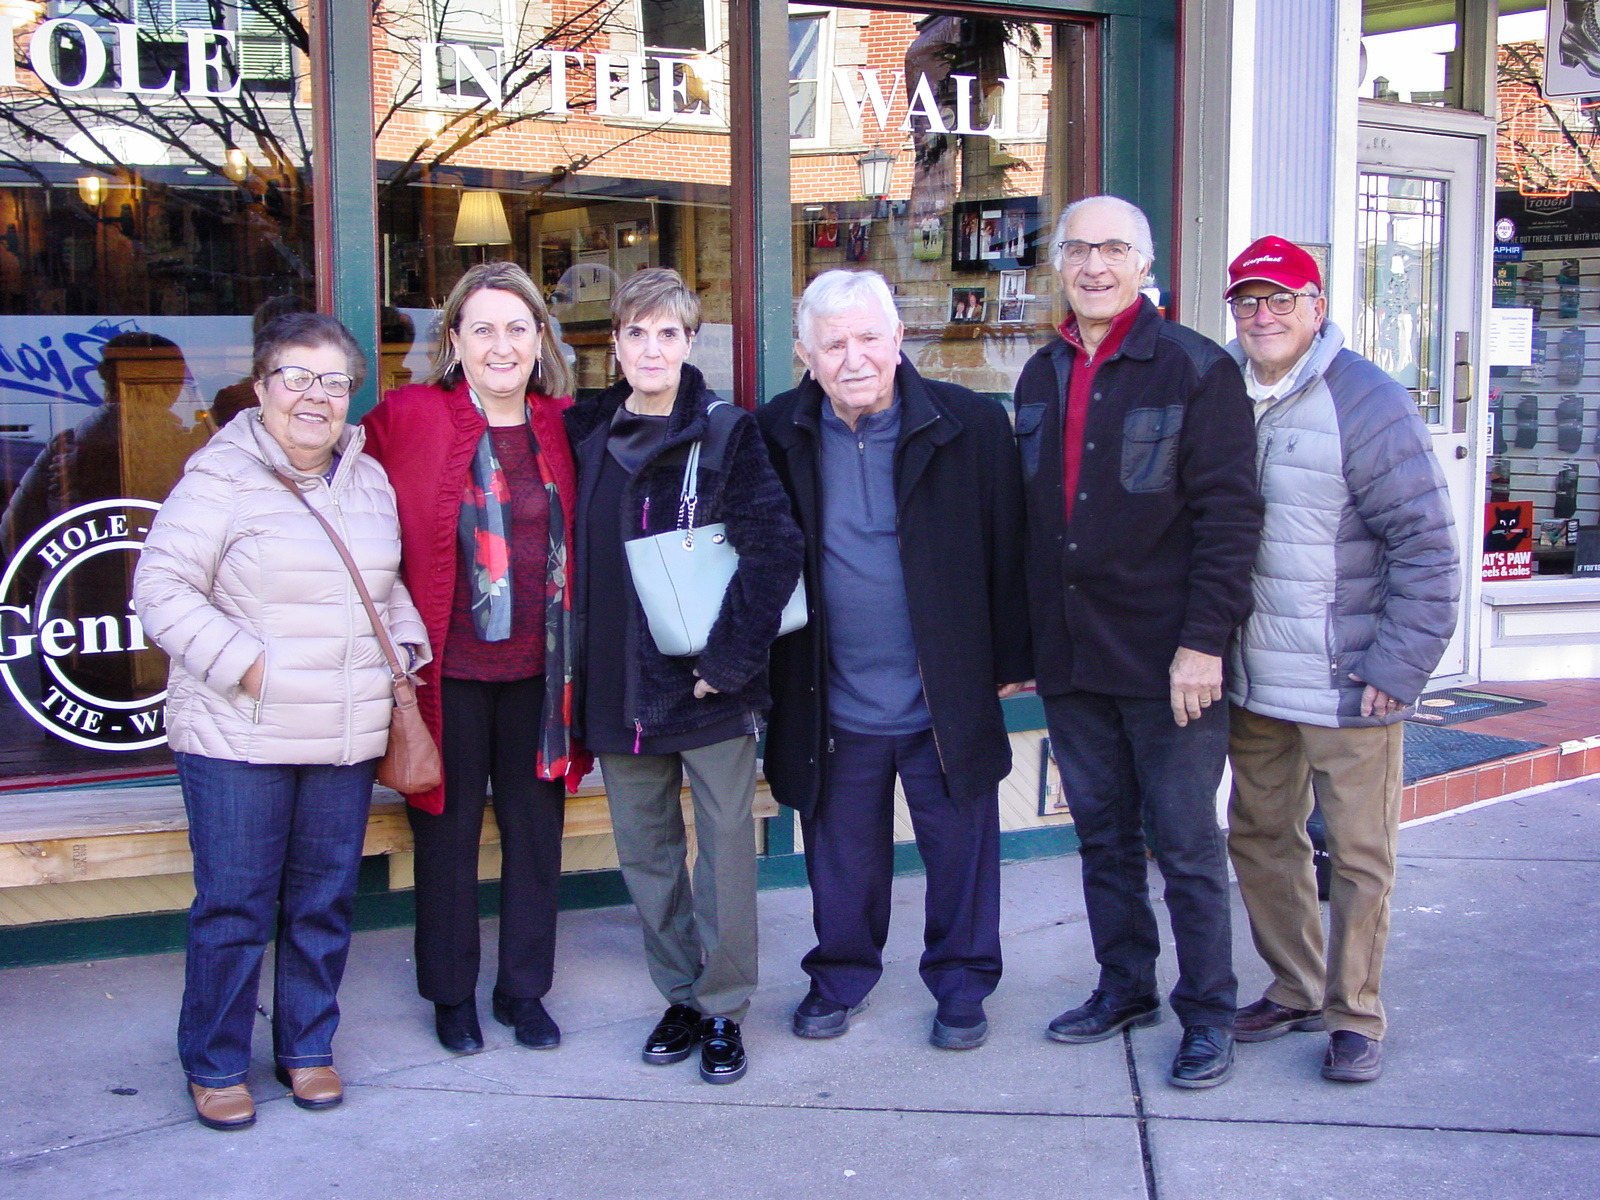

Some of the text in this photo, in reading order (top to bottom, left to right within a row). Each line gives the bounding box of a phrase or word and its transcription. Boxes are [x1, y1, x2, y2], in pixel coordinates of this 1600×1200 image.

[412, 43, 506, 112] IN
[532, 50, 711, 118] THE
[830, 67, 1041, 138] WALL
[1528, 198, 1567, 208] TOUGH
[1573, 232, 1590, 241] WITH
[1493, 246, 1520, 254] APHIR
[37, 514, 129, 569] HOLE
[1482, 551, 1532, 566] AT'S PAW
[1482, 565, 1531, 578] eels & soles
[0, 600, 160, 661] Geni
[41, 685, 104, 734] THE
